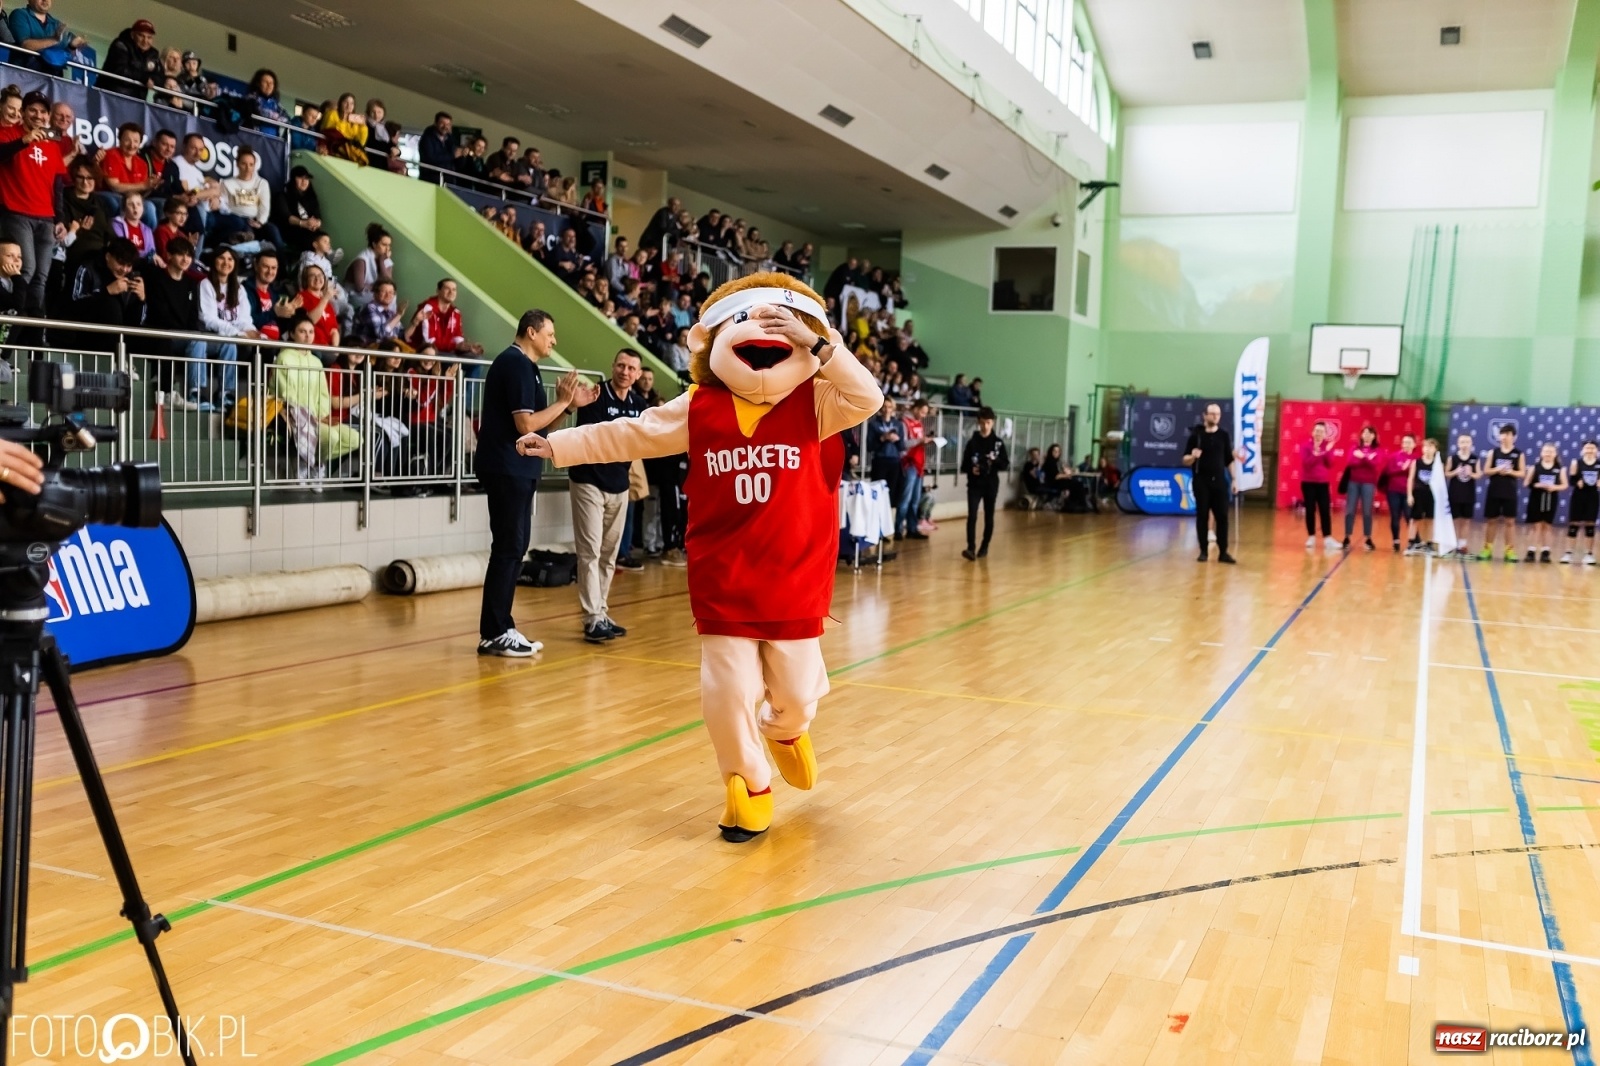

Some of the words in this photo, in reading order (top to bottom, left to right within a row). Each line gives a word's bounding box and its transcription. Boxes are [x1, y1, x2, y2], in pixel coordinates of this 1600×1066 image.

[1241, 373, 1258, 473] MINI
[703, 444, 800, 477] ROCKETS
[735, 472, 771, 504] 00
[58, 525, 150, 615] nba
